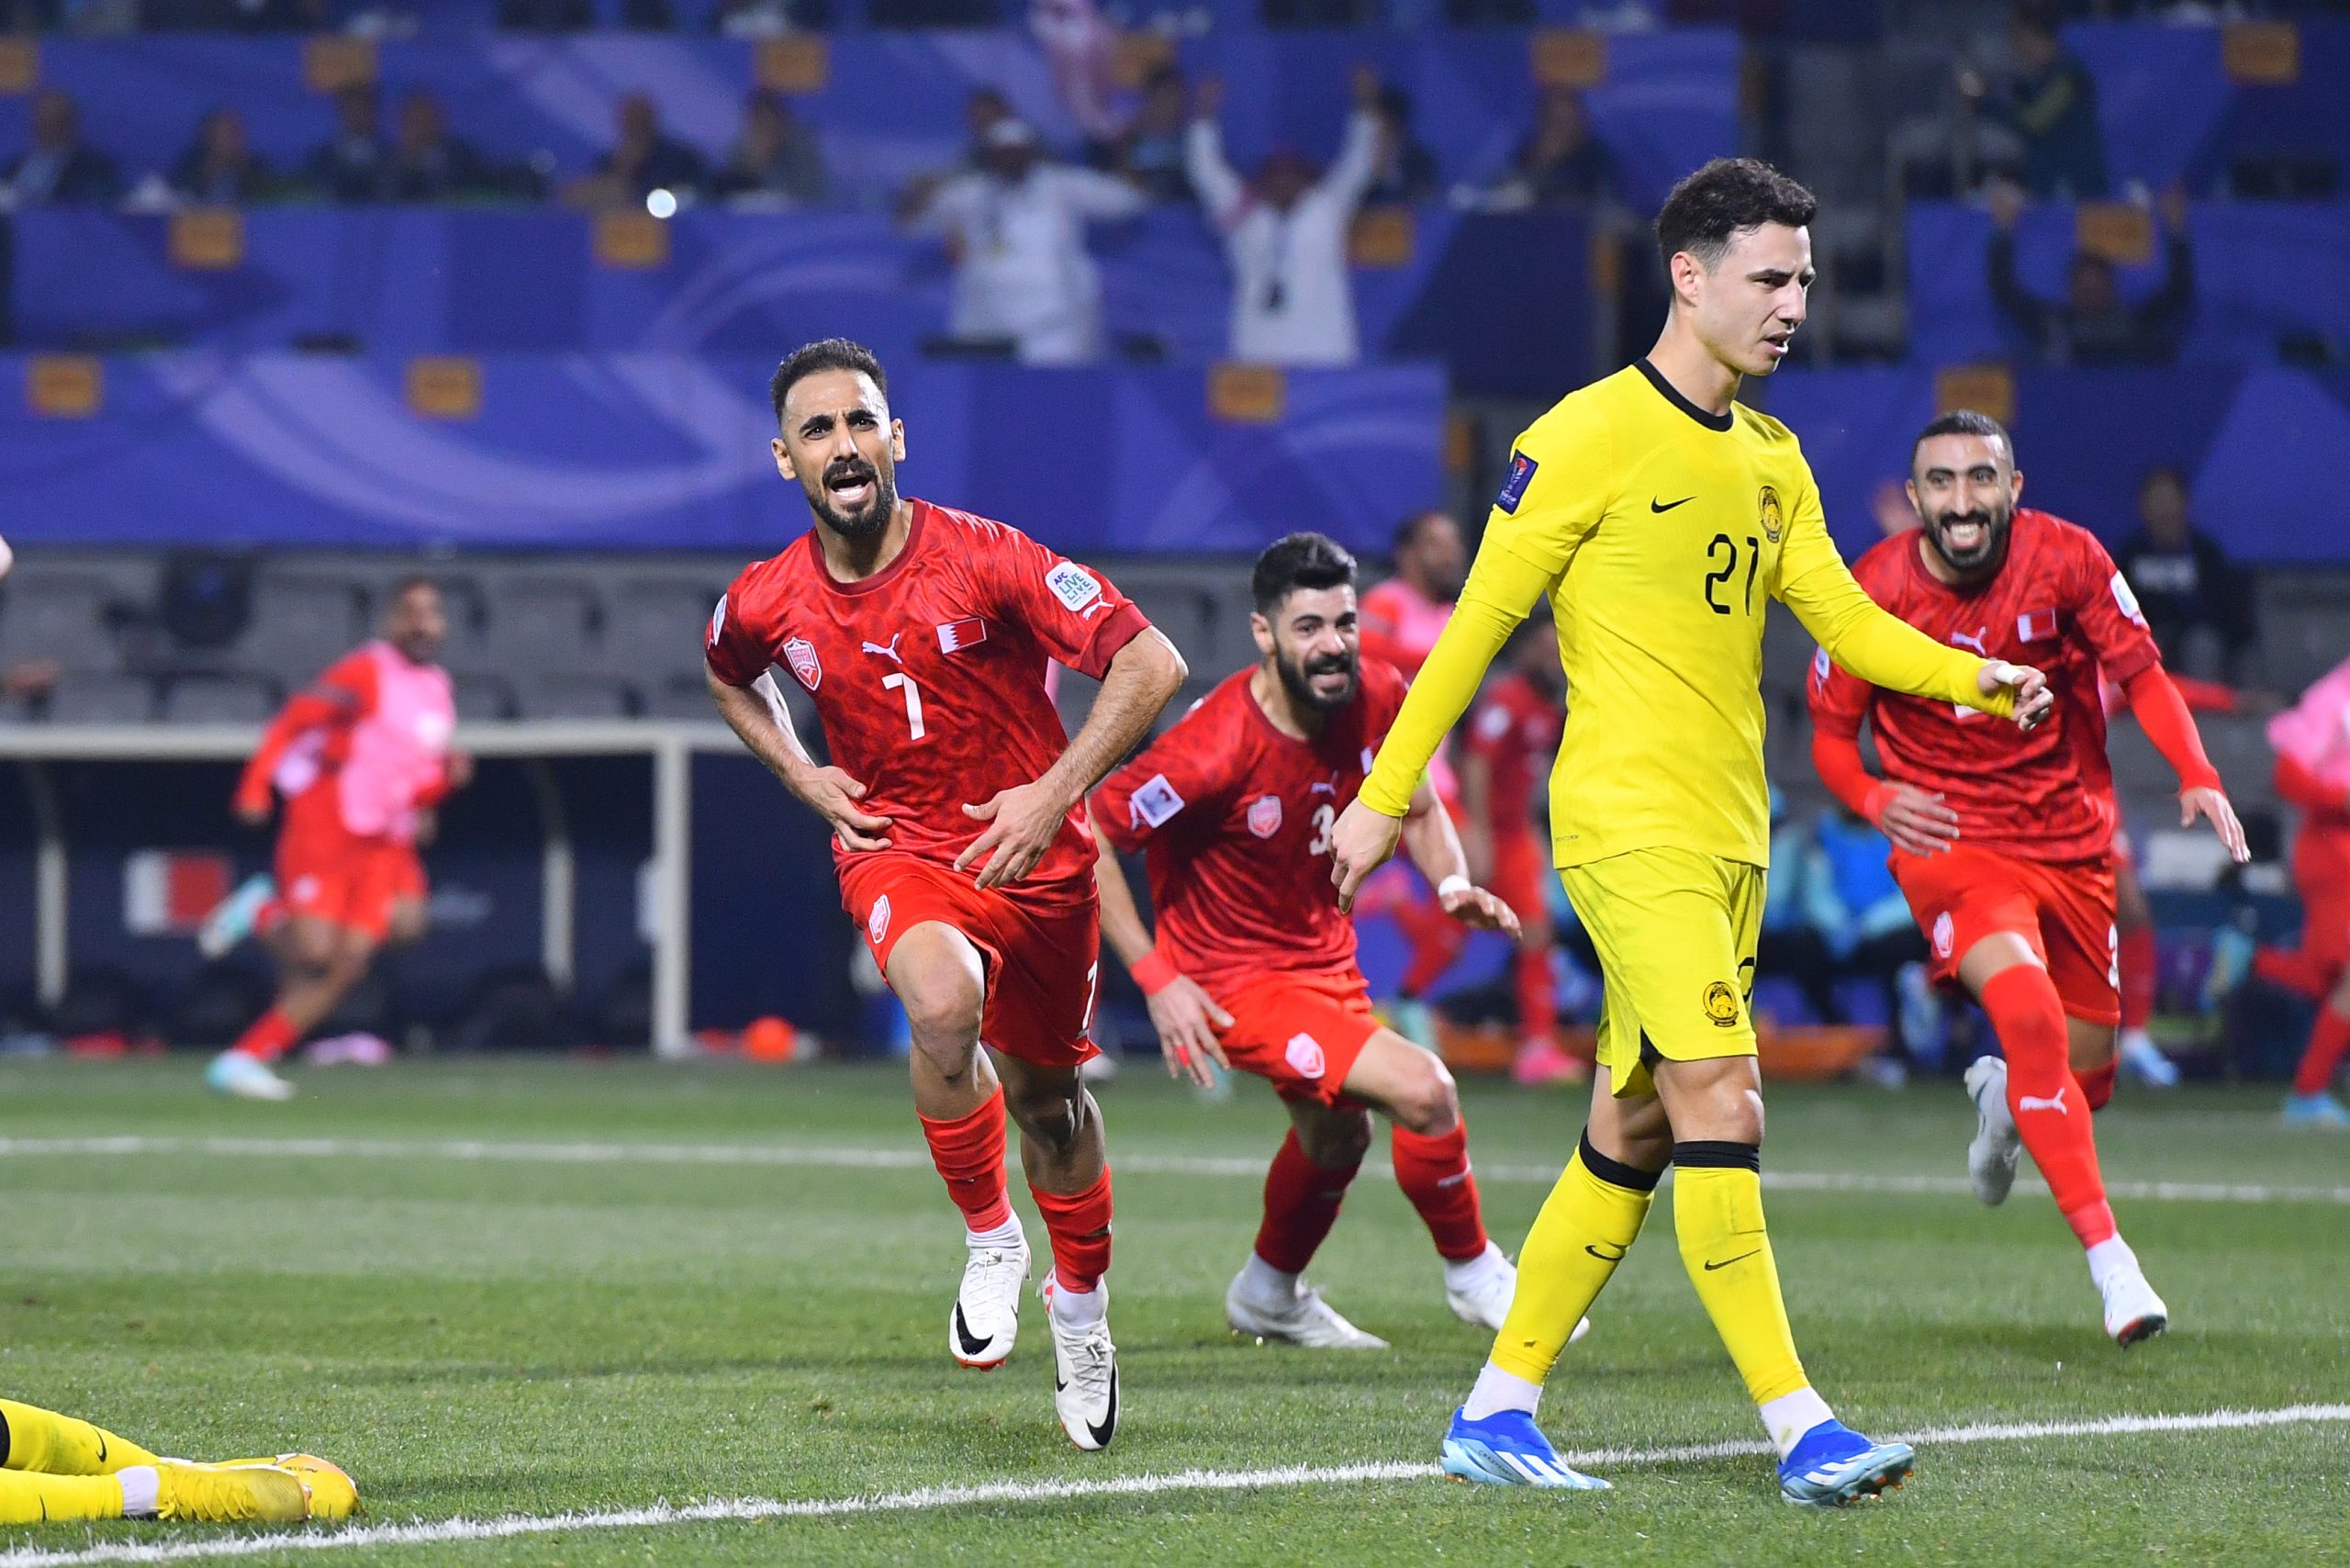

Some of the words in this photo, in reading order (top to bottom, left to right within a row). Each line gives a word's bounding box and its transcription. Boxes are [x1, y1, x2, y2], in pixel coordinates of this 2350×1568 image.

[1054, 572, 1069, 585] AFC
[1058, 573, 1084, 594] LIVE
[1705, 533, 1758, 616] 21
[881, 672, 925, 741] 7
[1309, 804, 1335, 856] 3
